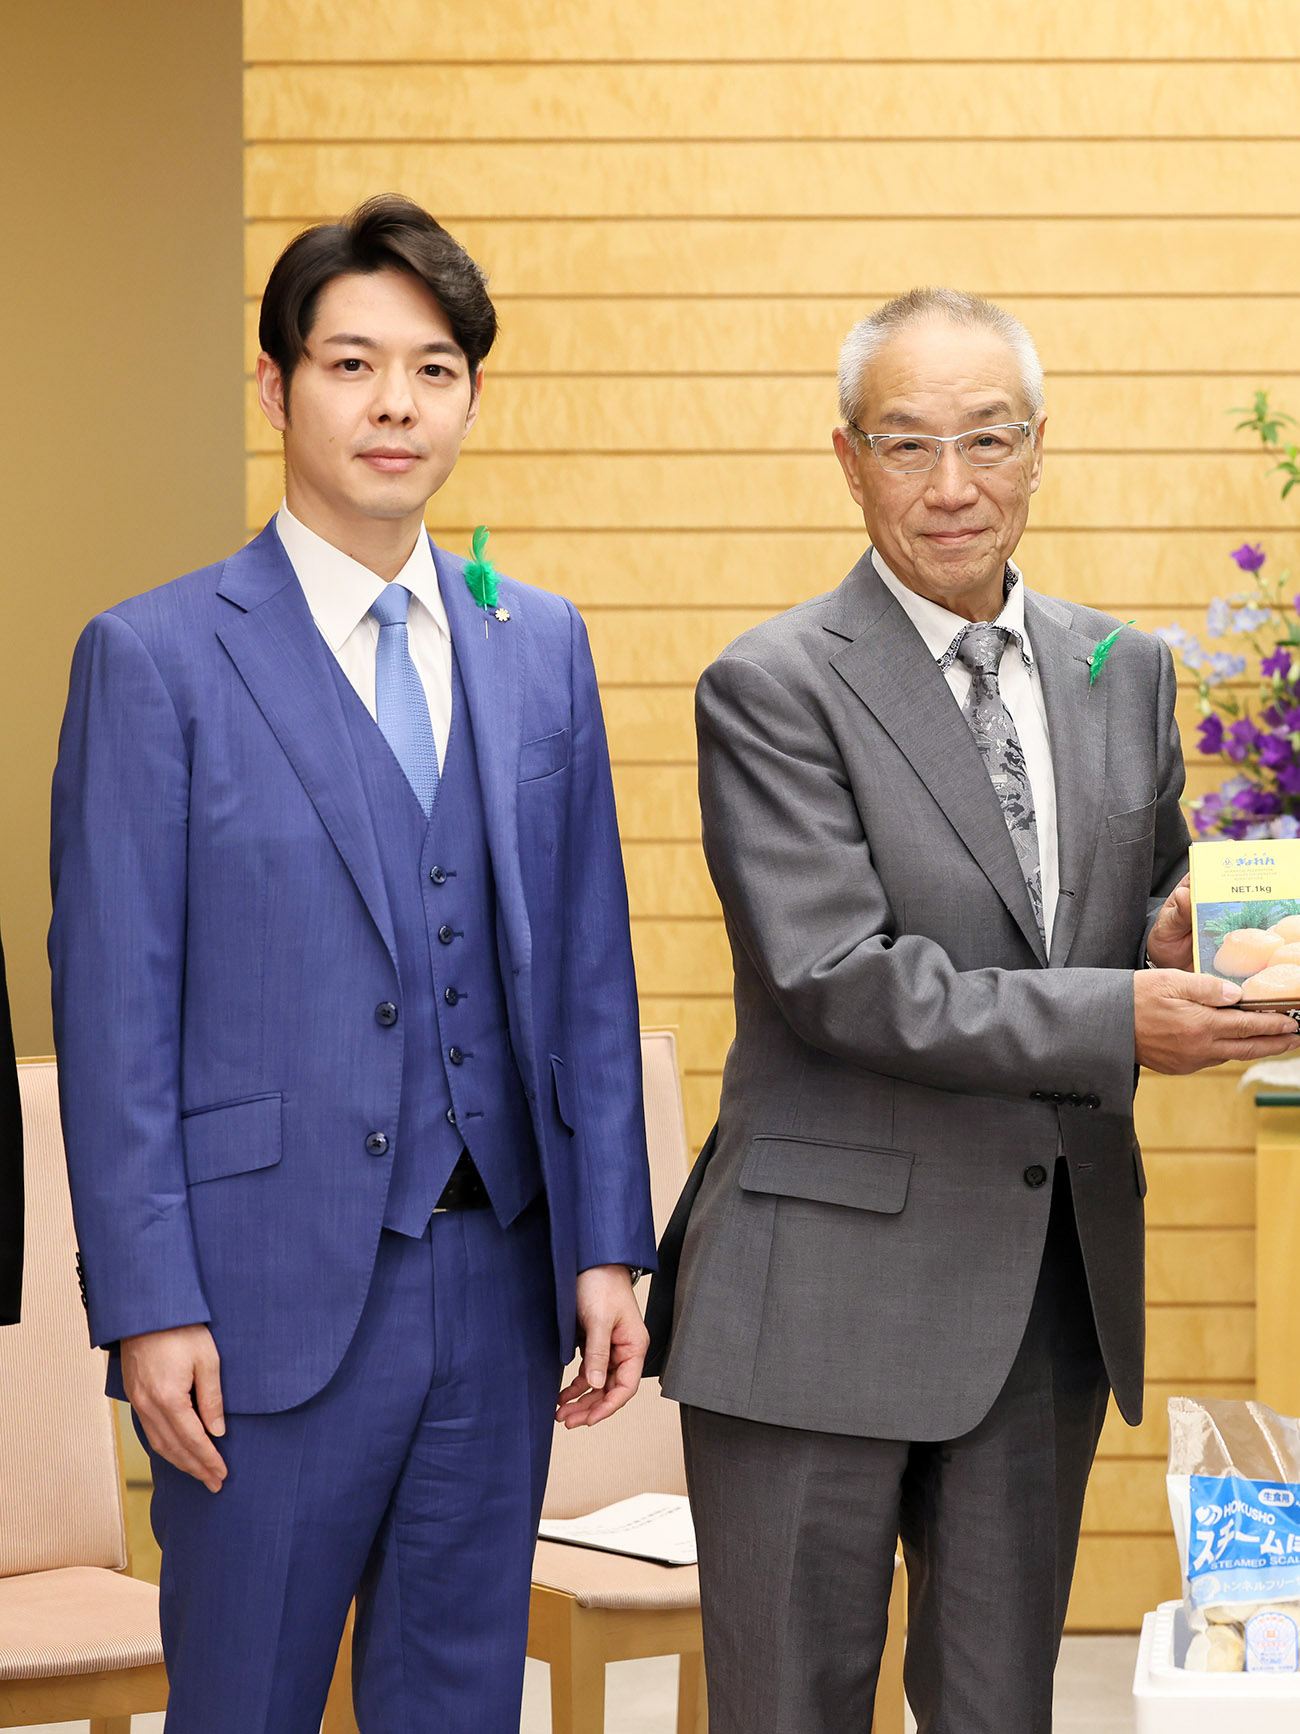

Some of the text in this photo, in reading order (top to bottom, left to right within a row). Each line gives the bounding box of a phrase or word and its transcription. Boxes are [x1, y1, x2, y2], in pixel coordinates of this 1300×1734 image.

[1263, 1492, 1290, 1503] 生食用
[1223, 1501, 1276, 1525] HOKUSHO
[1210, 1558, 1267, 1570] STEAMED
